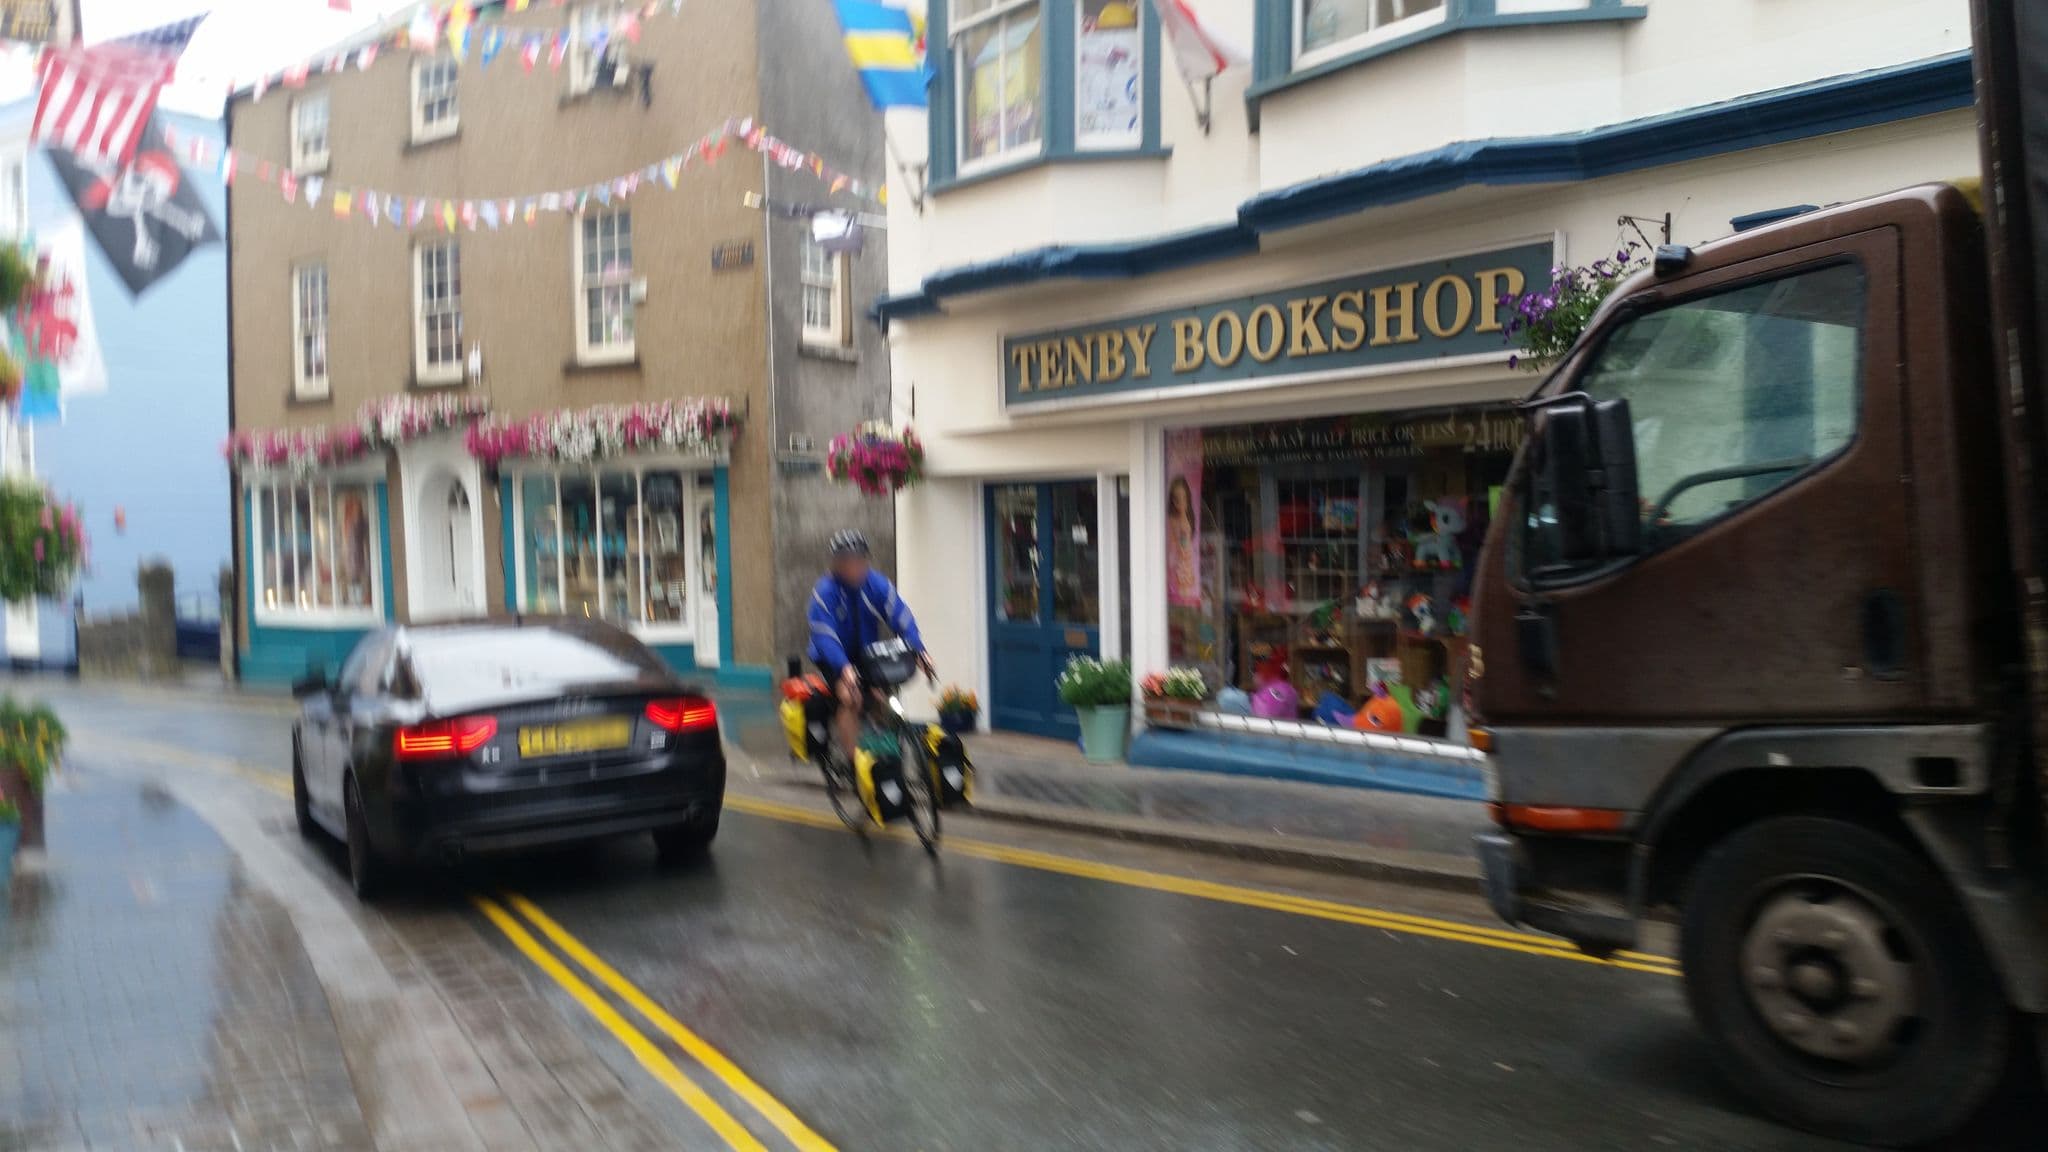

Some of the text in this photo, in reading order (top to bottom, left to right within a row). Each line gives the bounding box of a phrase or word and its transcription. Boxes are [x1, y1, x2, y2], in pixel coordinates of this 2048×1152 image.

[1011, 266, 1525, 392] TENBY BOOKSHOP
[1311, 429, 1345, 449] HALF
[1351, 424, 1391, 447] PRICE
[1393, 421, 1415, 442] OR
[1420, 417, 1456, 441] LESS
